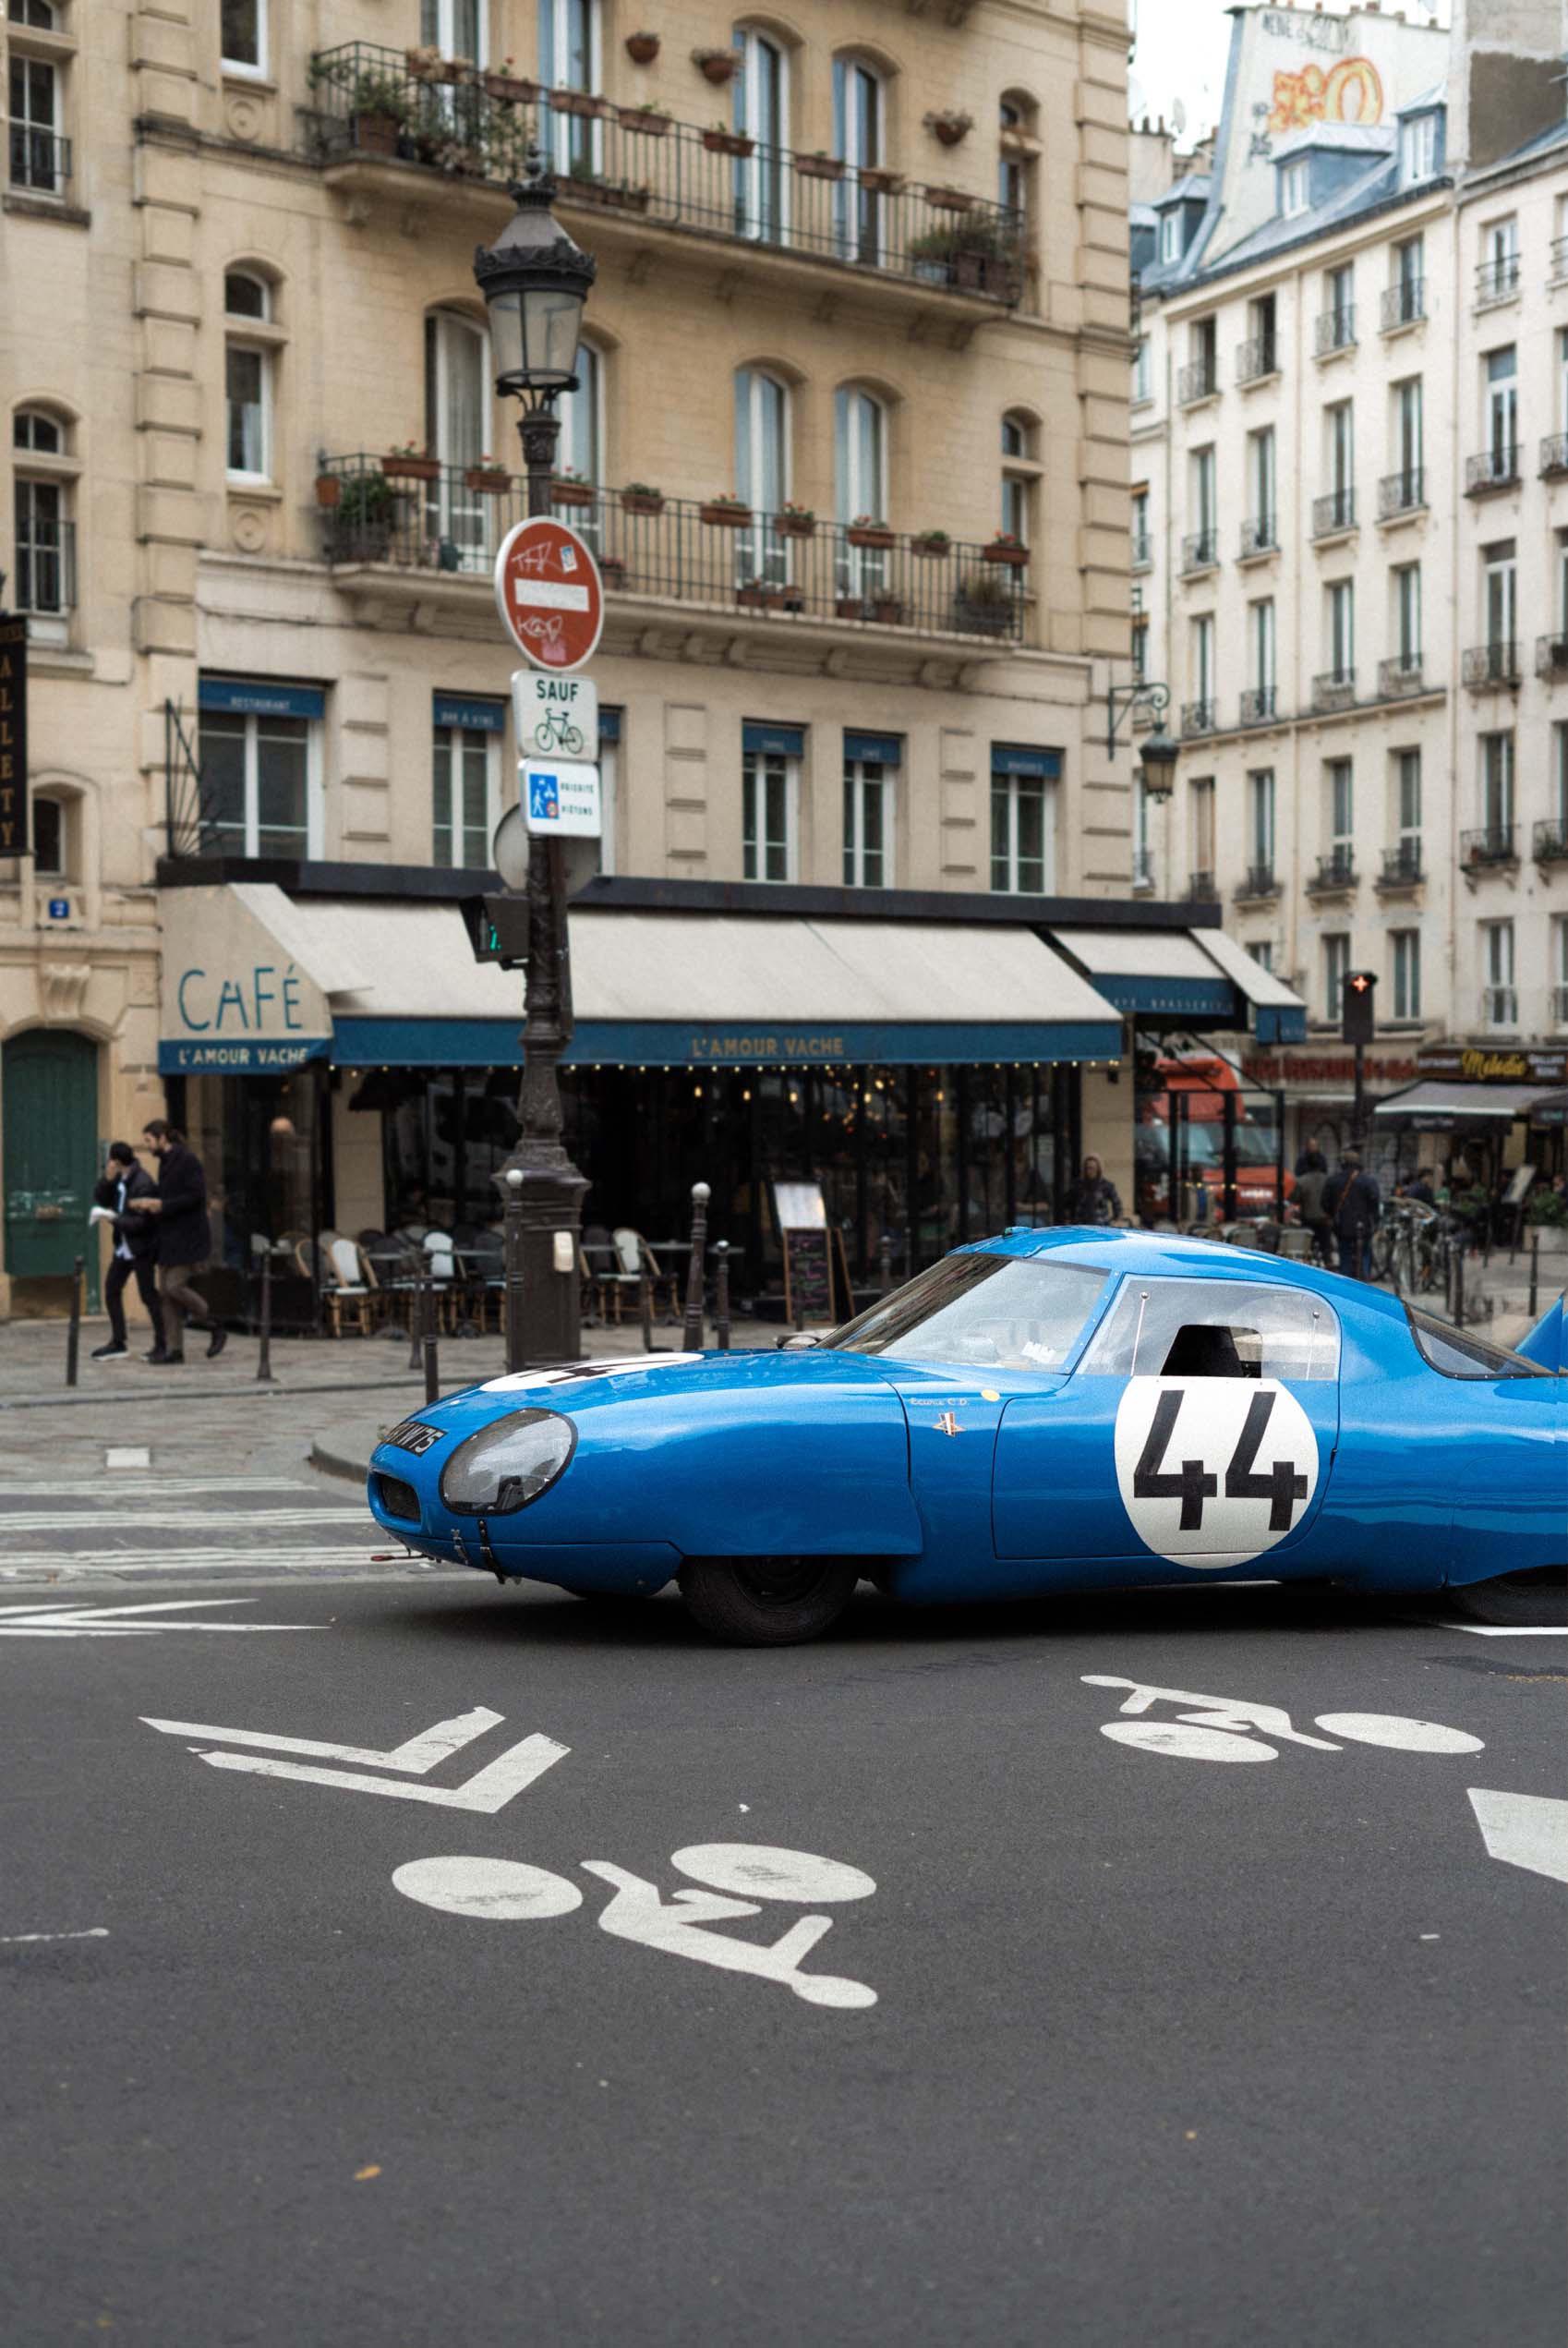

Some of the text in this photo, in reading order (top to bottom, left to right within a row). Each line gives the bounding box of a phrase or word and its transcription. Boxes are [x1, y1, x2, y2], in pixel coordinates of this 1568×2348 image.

[536, 679, 578, 702] SAUF
[178, 964, 302, 1031] CAFÉ
[179, 1048, 308, 1064] L'AMOUR VACHE
[692, 1036, 843, 1057] L'AMOUR VACHE
[1134, 1390, 1308, 1531] 44
